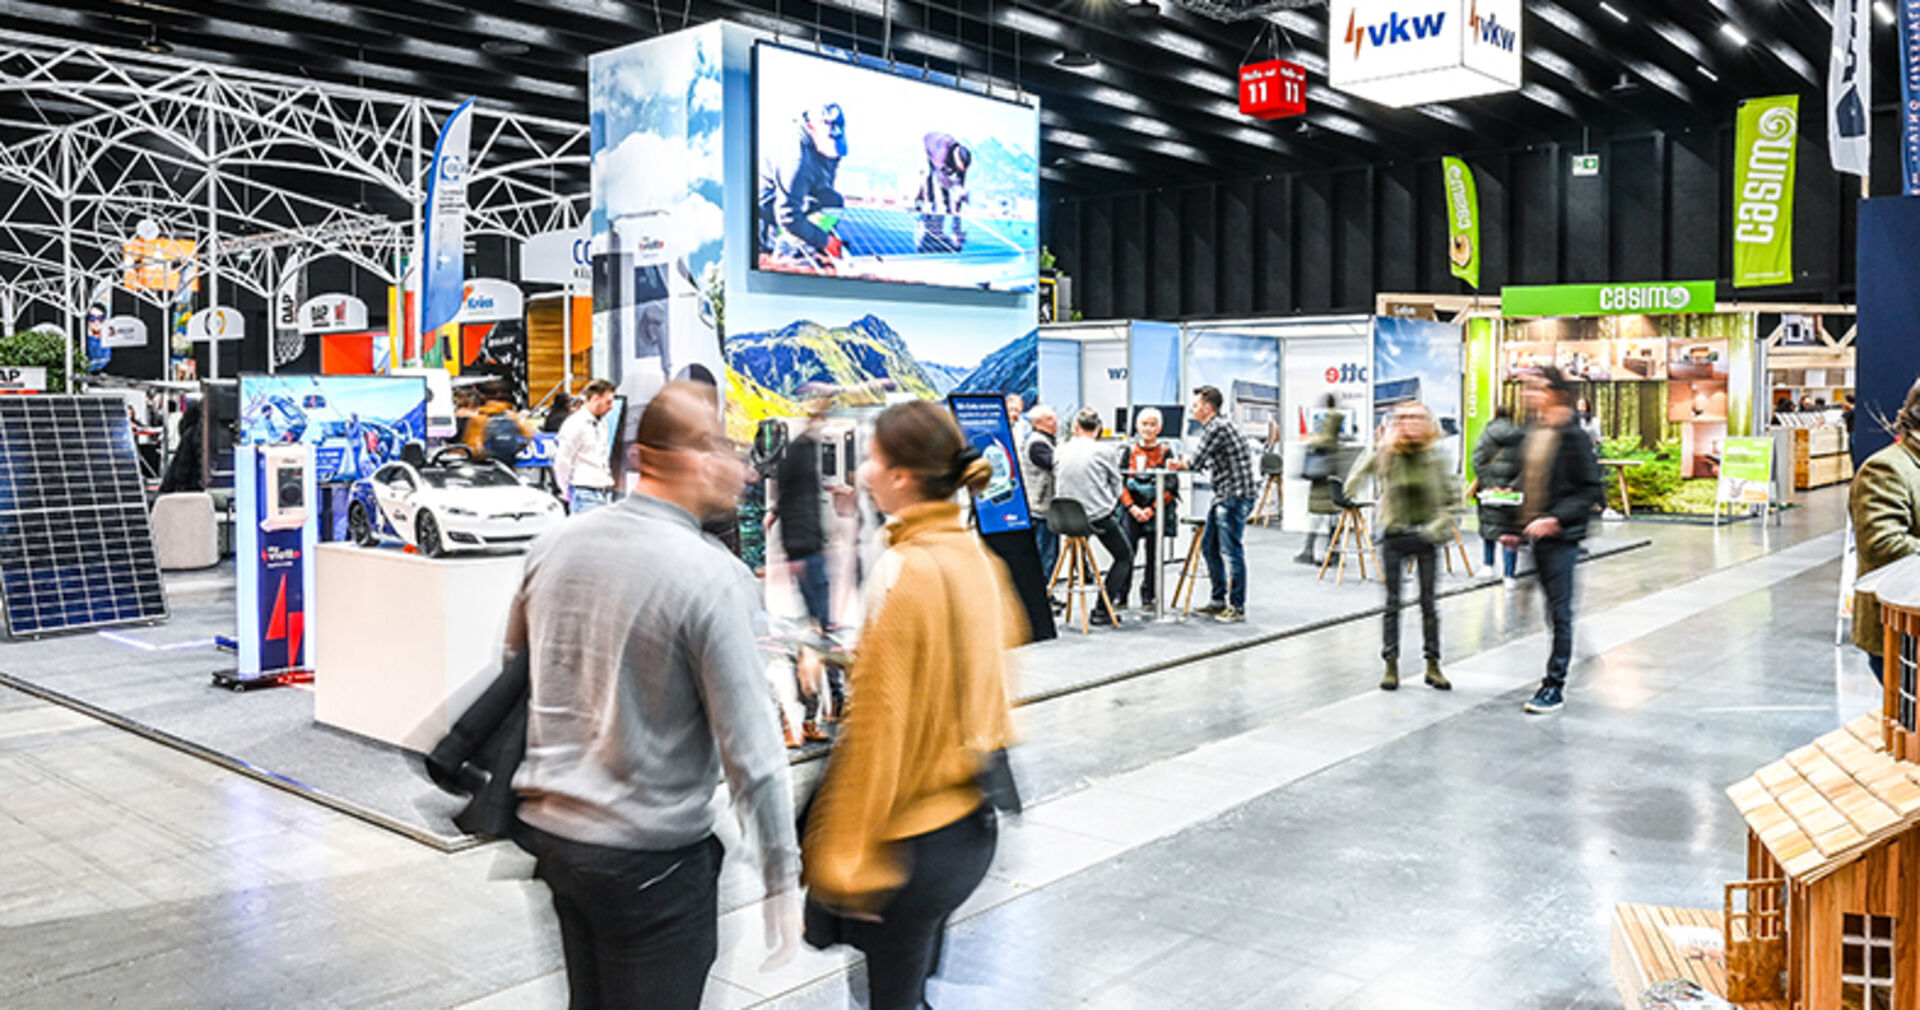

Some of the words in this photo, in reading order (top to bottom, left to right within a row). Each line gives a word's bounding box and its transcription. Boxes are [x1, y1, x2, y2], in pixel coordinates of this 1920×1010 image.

[1367, 11, 1446, 47] vkw
[1481, 13, 1516, 52] vkw
[1249, 82, 1267, 104] 11
[1285, 81, 1299, 104] 11
